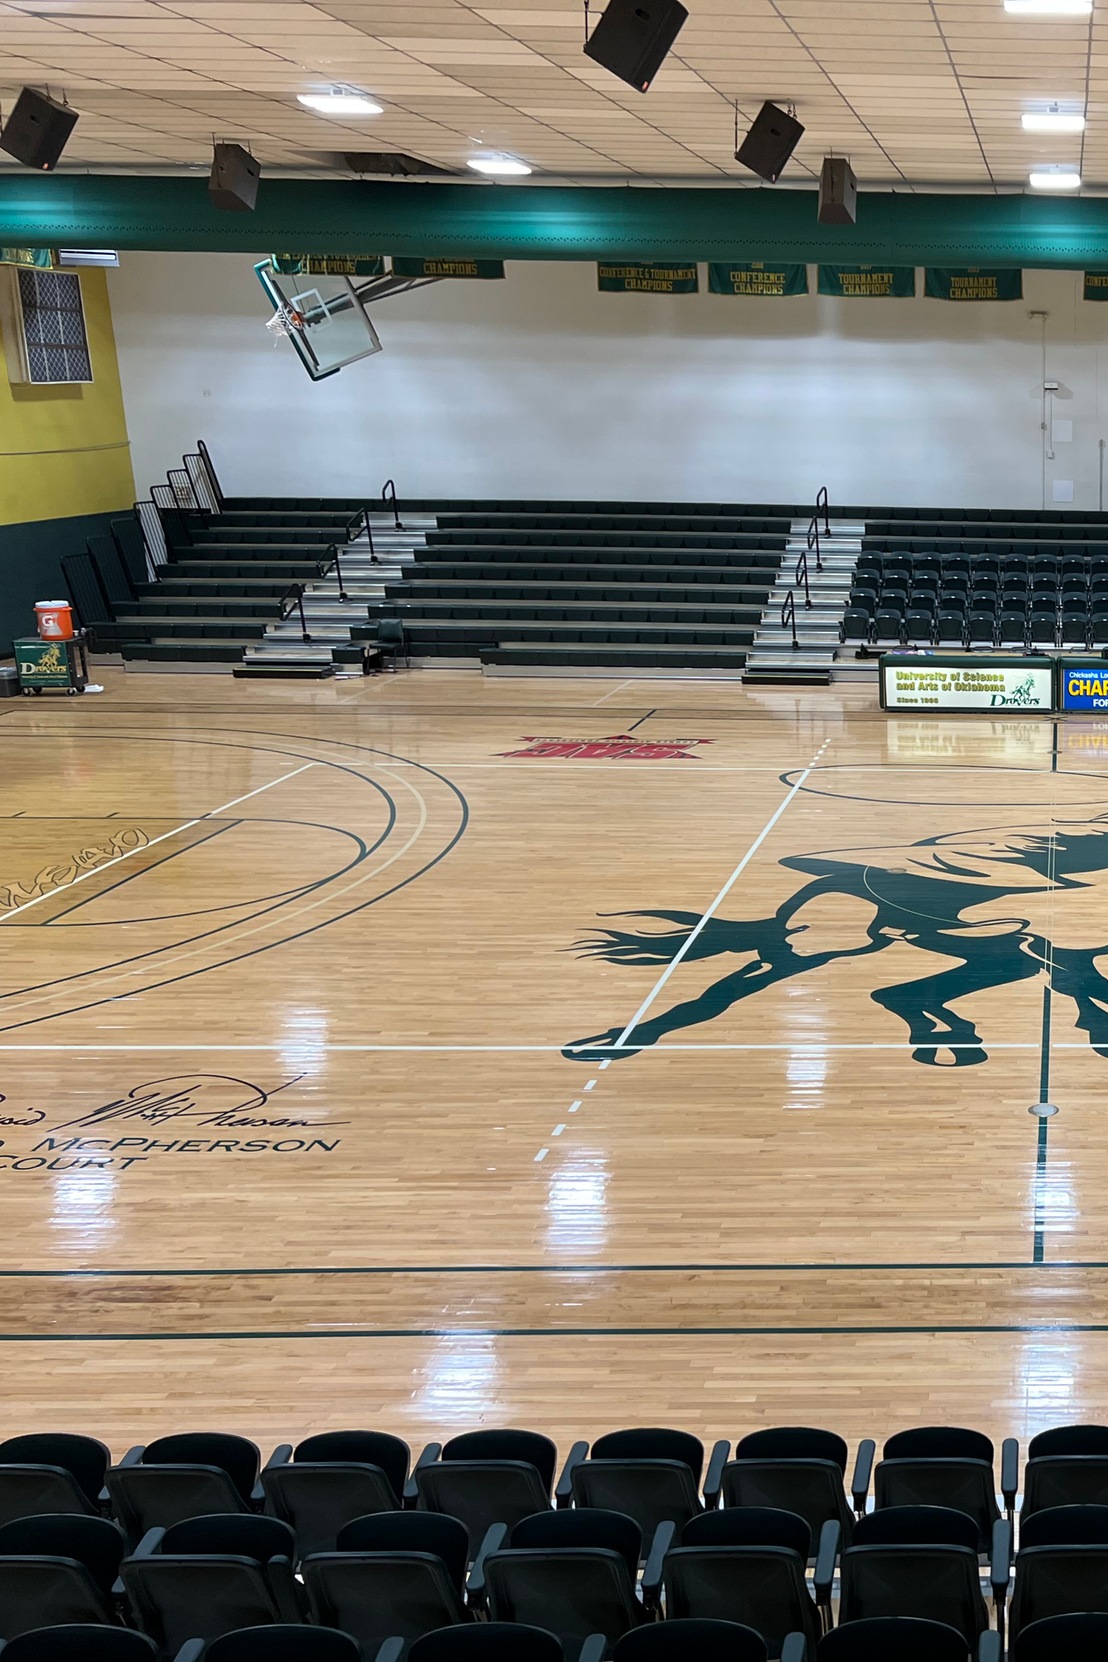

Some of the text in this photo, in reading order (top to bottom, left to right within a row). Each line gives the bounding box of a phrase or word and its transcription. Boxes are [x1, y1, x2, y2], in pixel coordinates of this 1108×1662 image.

[301, 260, 356, 273] CHAMPIONS
[423, 262, 478, 275] CHAMPIONS
[600, 267, 643, 279] CONFERENCE
[651, 268, 696, 280] TOURNAMENT
[730, 271, 786, 283] CONFERENCE
[838, 273, 894, 285] TOURNAMENT
[624, 280, 673, 291] CHAMPIONS
[951, 277, 997, 288] TOURNAMENT
[734, 283, 784, 295] CHAMPIONS
[843, 284, 890, 295] CHAMPIONS
[950, 288, 998, 298] CHAMPIONS
[42, 615, 54, 627] G
[20, 662, 67, 675] Drovers
[895, 671, 1005, 682] University of Science
[896, 682, 1006, 692] and Arts of Oklahoma
[990, 694, 1040, 707] Drovers
